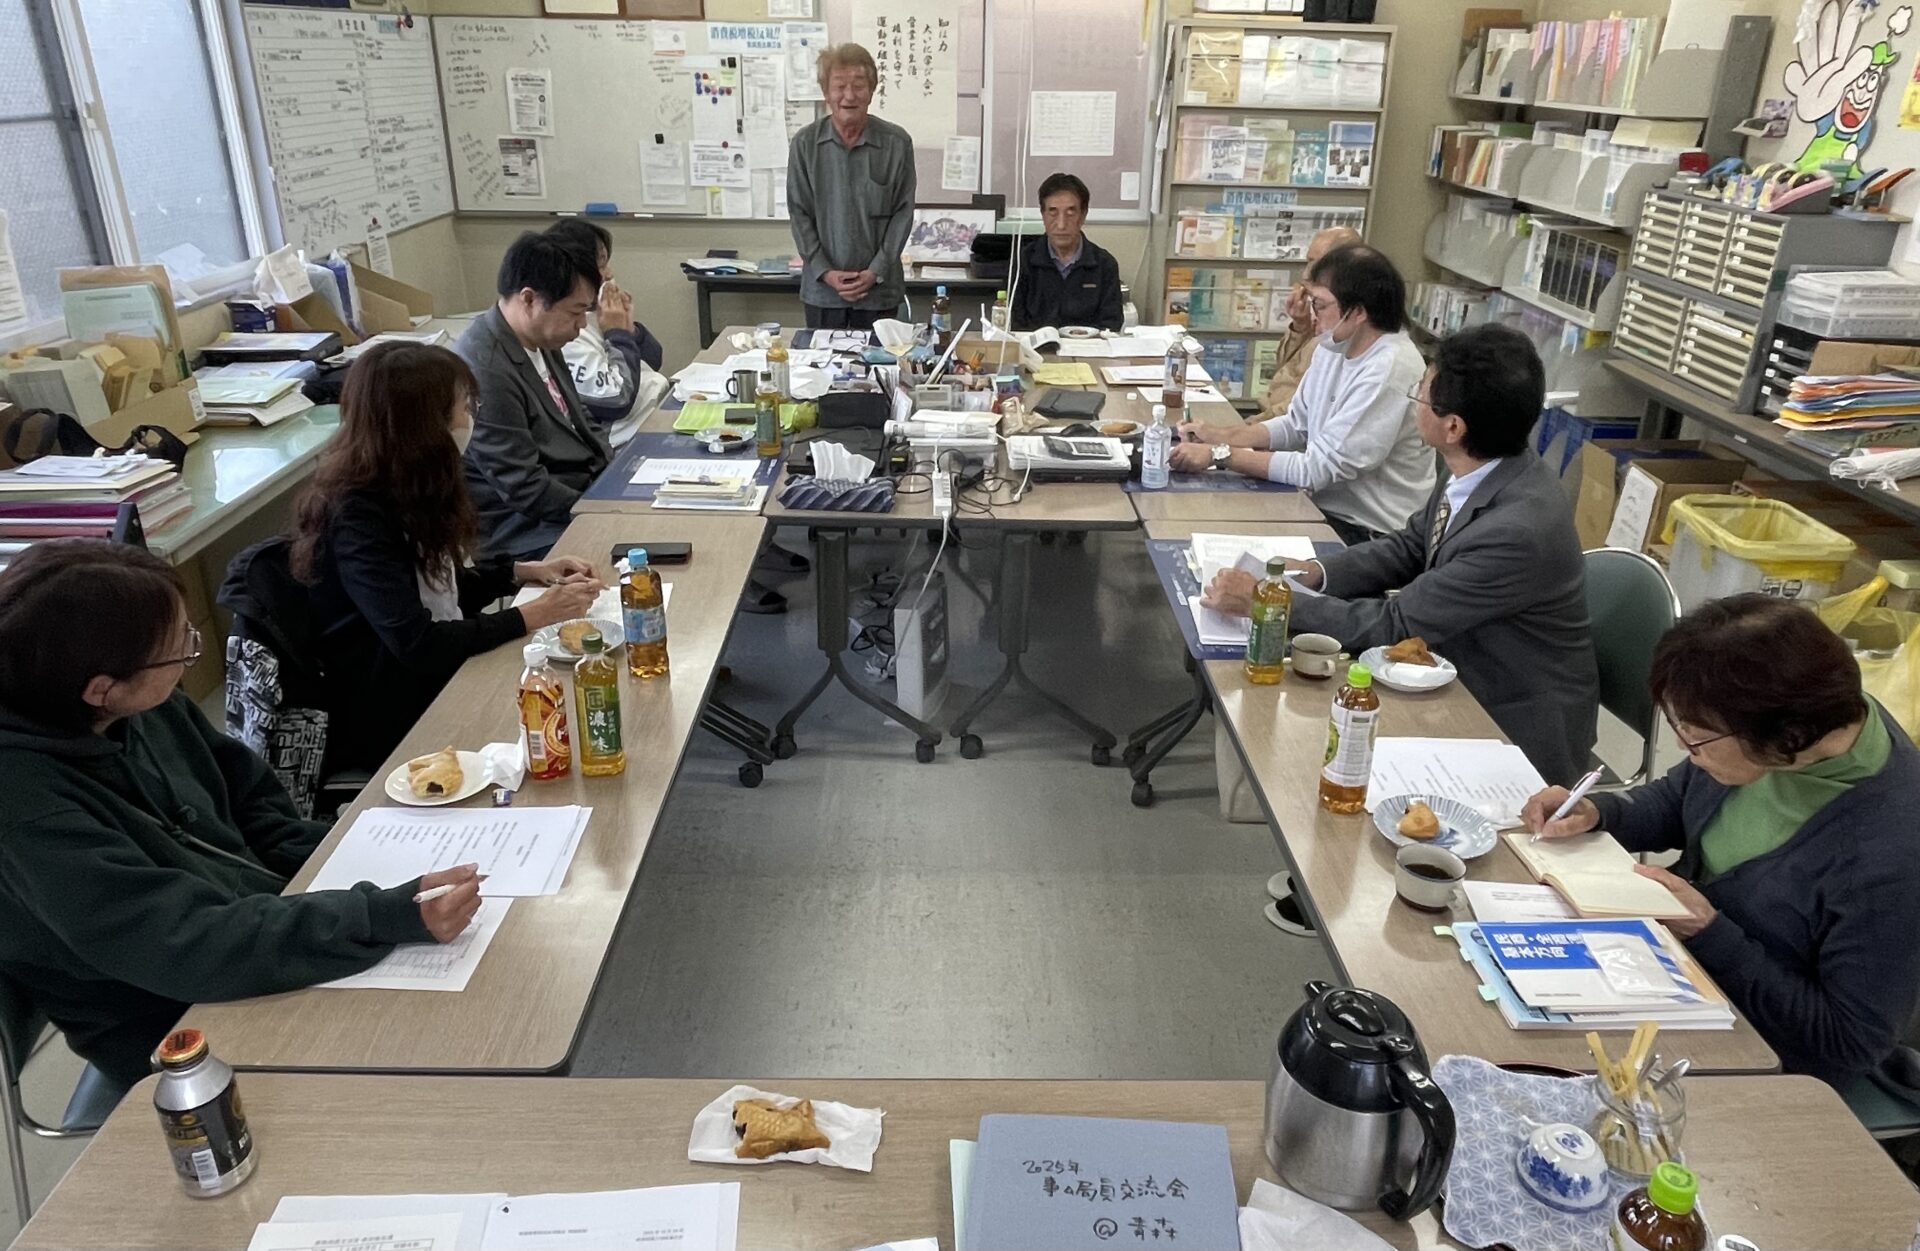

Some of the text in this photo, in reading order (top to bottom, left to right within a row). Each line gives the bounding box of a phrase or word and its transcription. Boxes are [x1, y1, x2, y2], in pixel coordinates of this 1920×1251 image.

[938, 17, 950, 53] 知は力
[923, 23, 934, 97] 大いに学び合い
[589, 709, 609, 751] 濃い味
[1501, 946, 1569, 958] 基本方向
[1022, 1159, 1081, 1175] 2025年
